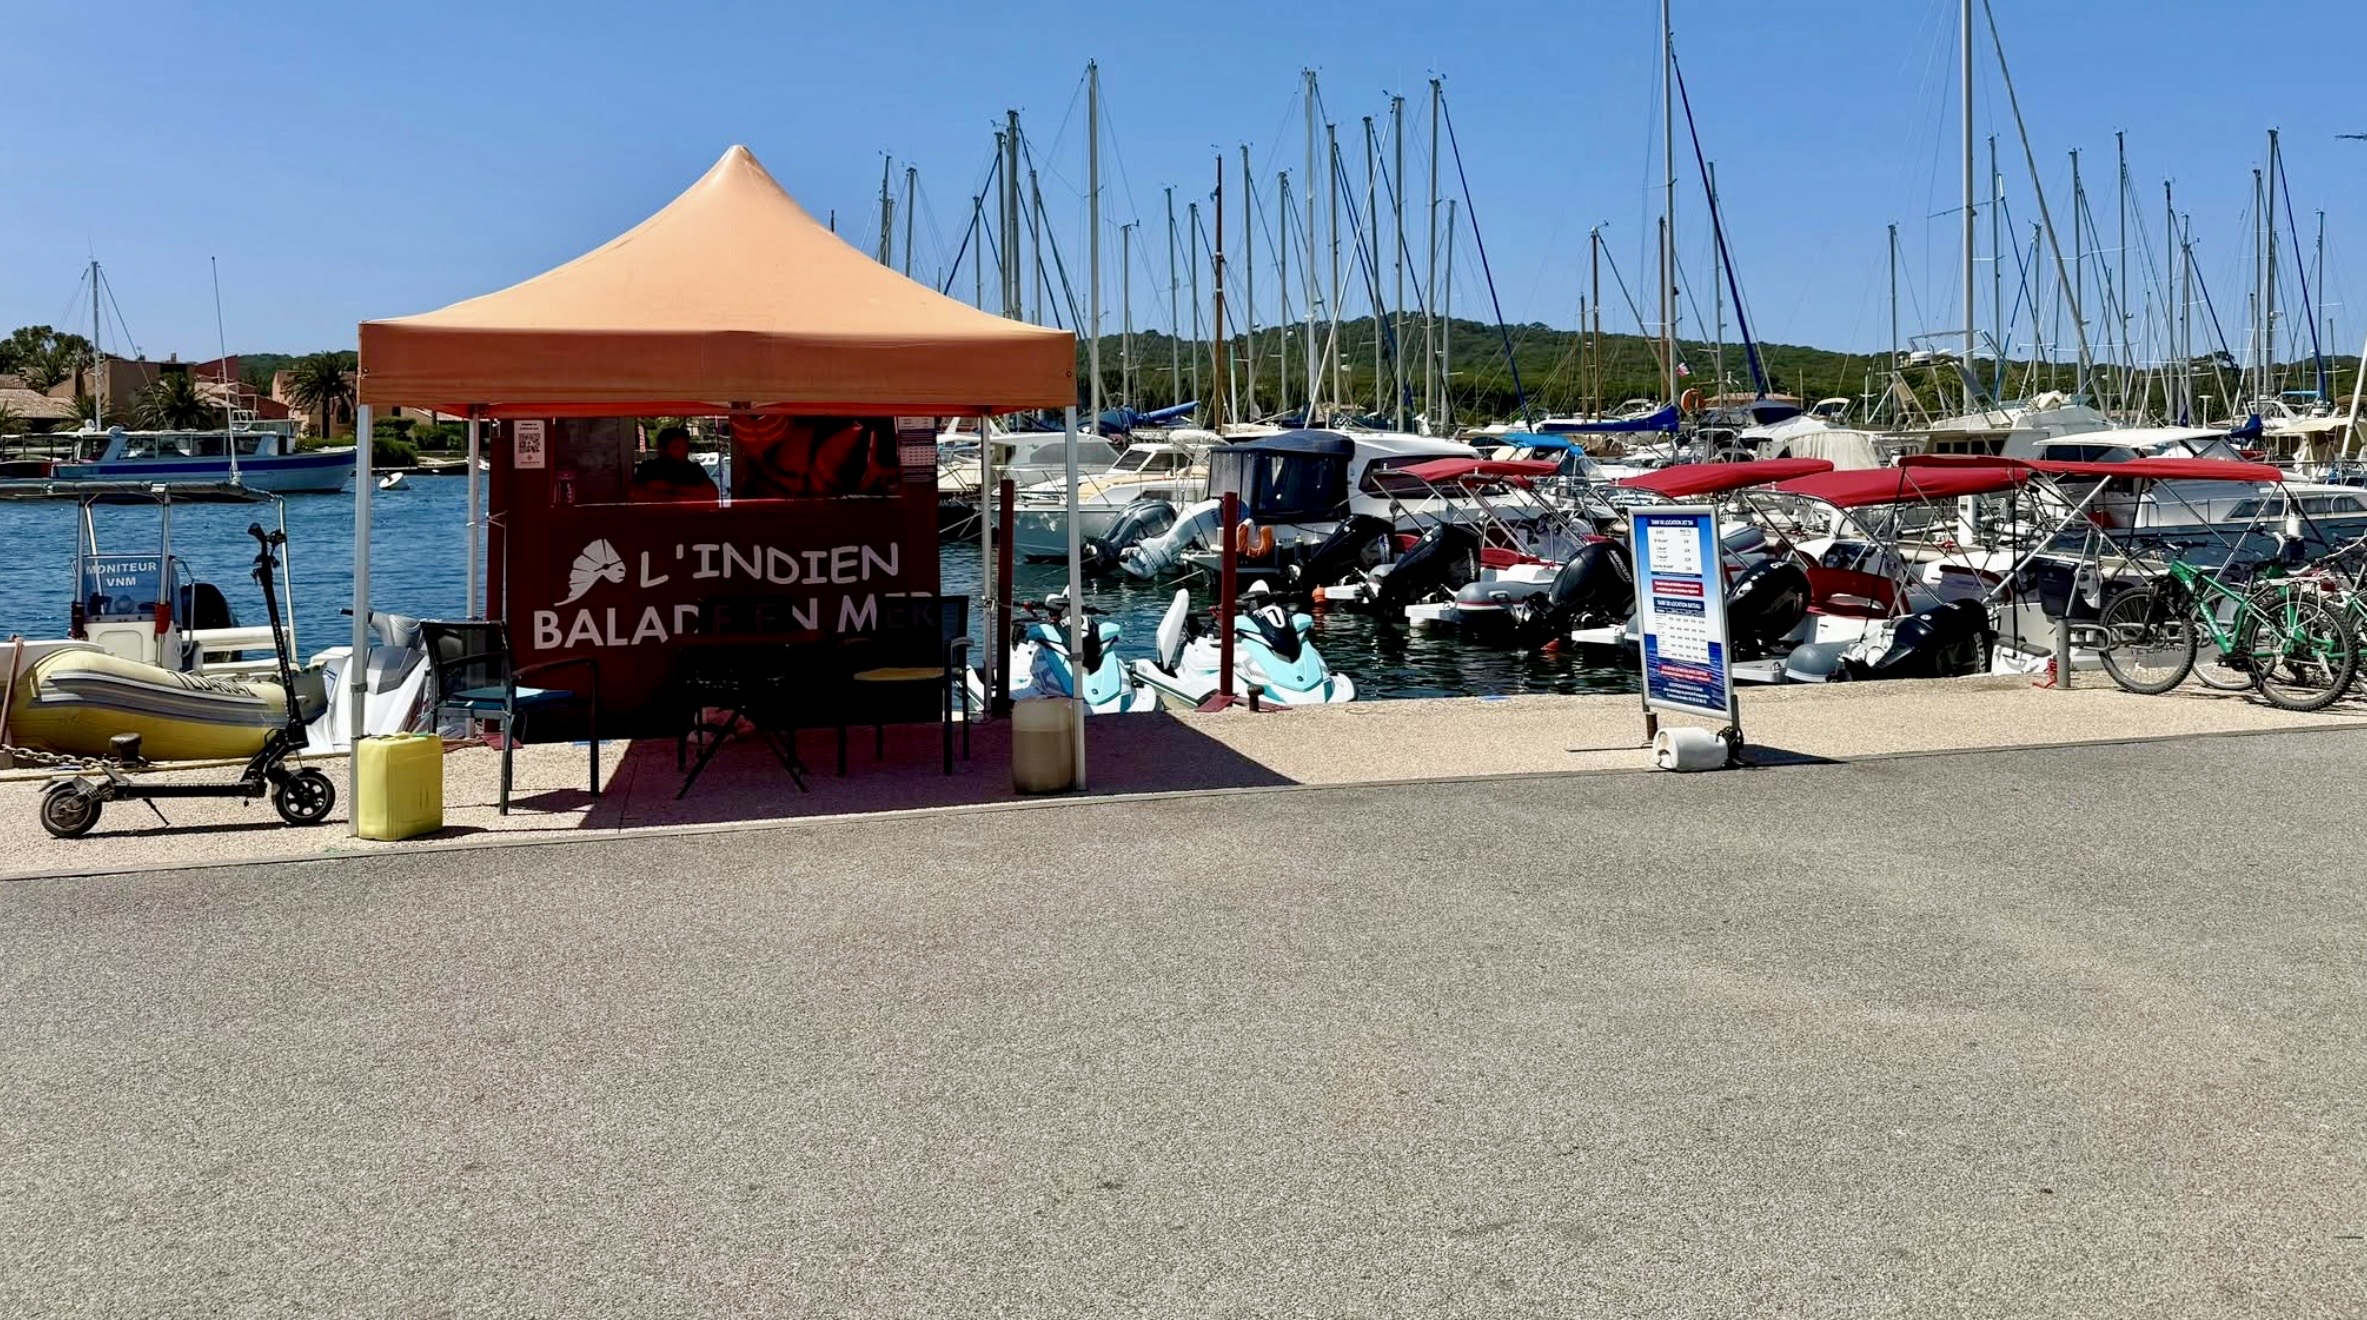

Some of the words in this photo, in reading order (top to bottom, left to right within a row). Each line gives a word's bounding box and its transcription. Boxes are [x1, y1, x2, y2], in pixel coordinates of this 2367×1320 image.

[85, 562, 157, 575] MONITEUR
[639, 541, 900, 588] L'INDIEN
[106, 576, 137, 587] VNM
[1973, 632, 1987, 673] SUZU
